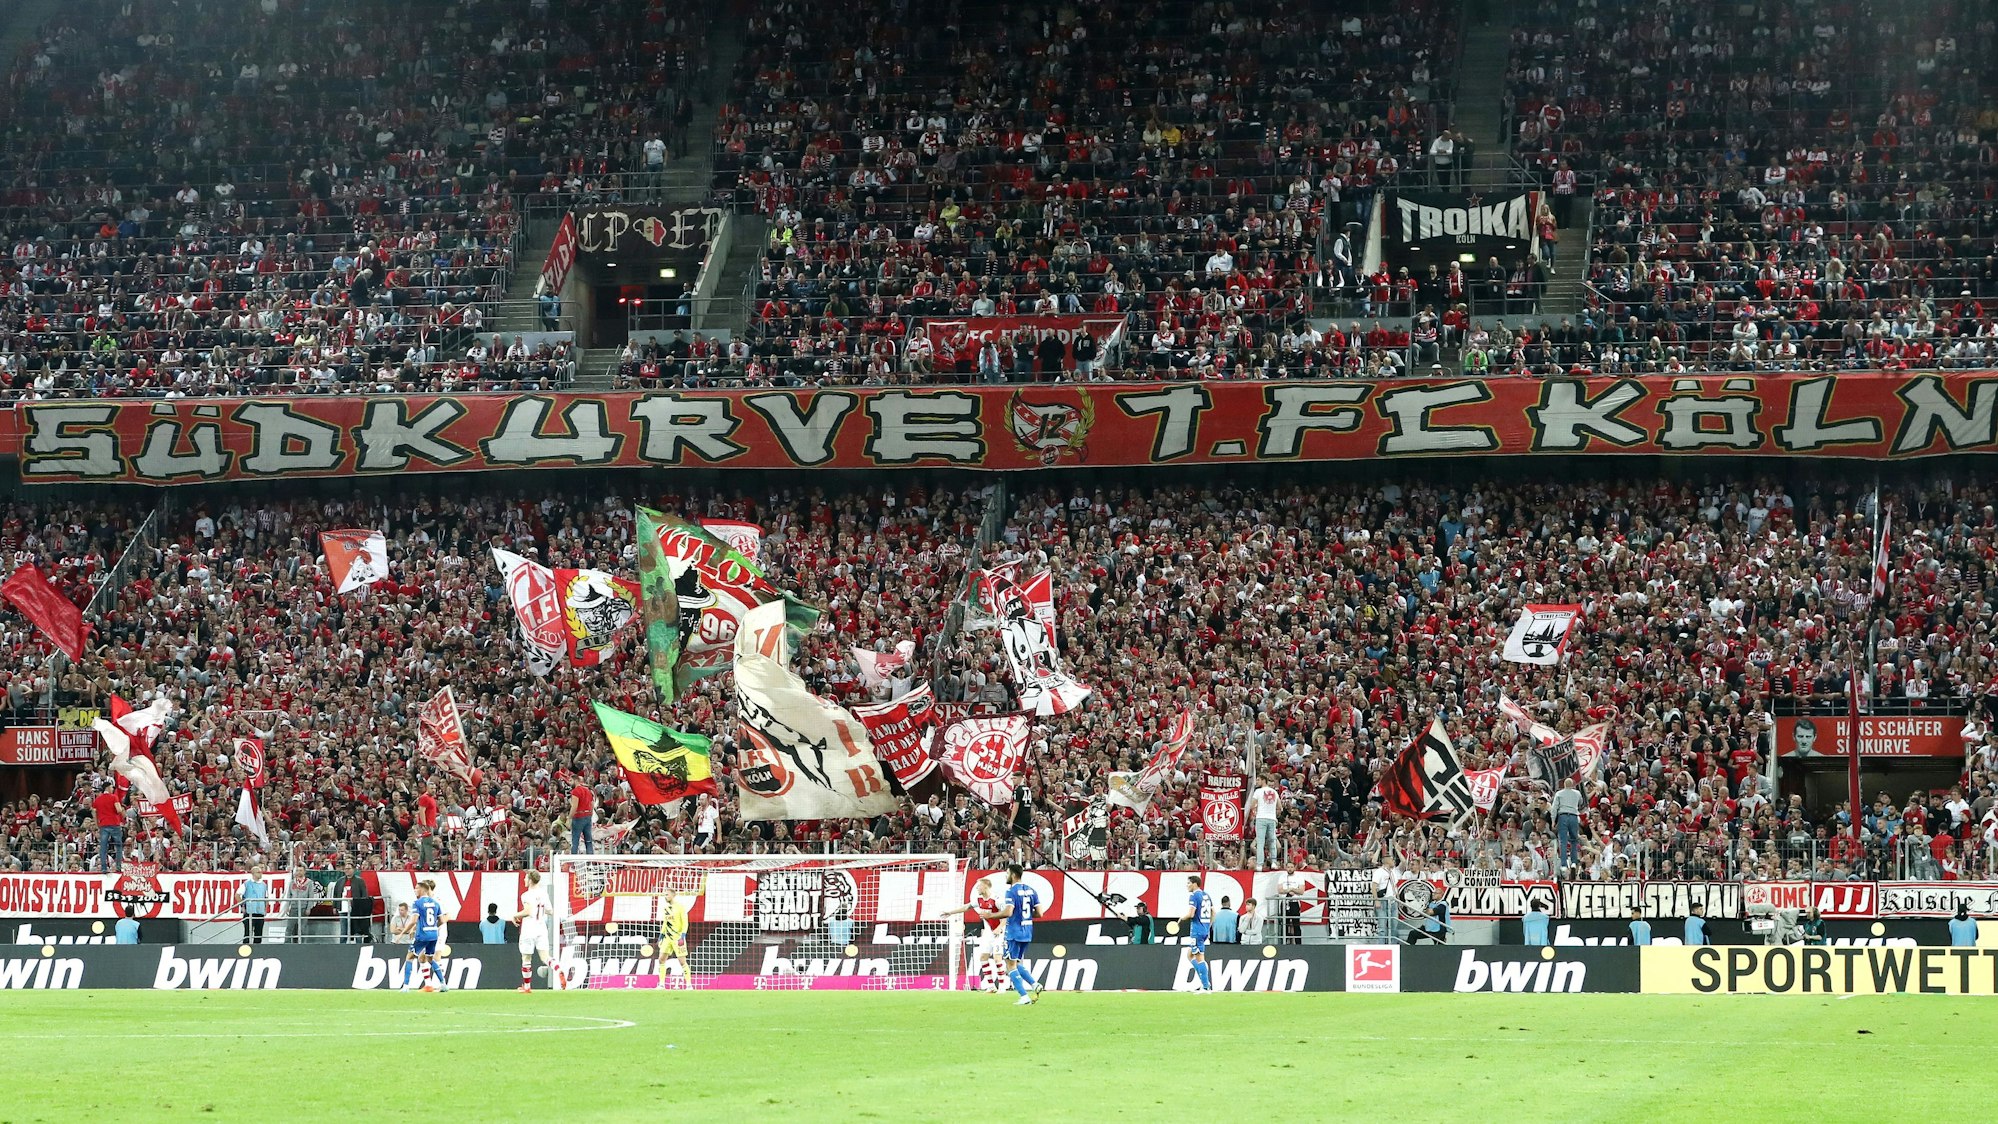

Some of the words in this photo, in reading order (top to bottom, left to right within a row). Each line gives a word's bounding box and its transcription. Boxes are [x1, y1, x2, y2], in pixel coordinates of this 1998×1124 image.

[1397, 194, 1530, 243] TROIKA
[22, 391, 986, 481] SÜDKURVE
[1530, 374, 1998, 455] KÖLN
[1038, 413, 1066, 439] 12
[701, 611, 737, 642] 96
[16, 730, 50, 745] HANS
[1878, 719, 1943, 736] SCHÄFER
[745, 769, 773, 785] KÖLN
[1207, 775, 1242, 787] RAFIKIS
[1022, 788, 1032, 804] 44
[760, 872, 823, 890] SEKTION
[1327, 869, 1372, 881] VIRAG
[1327, 882, 1372, 894] AUTEU
[760, 890, 822, 914] STADT
[1021, 896, 1031, 919] 5
[1818, 887, 1871, 913] AJJ
[1879, 889, 1976, 913] Kölsche
[426, 907, 435, 926] 6
[760, 913, 821, 931] VERBOT
[153, 944, 282, 990] bwin
[760, 944, 890, 977] bwin
[1172, 944, 1310, 992] bwin
[1453, 946, 1587, 993] bwin
